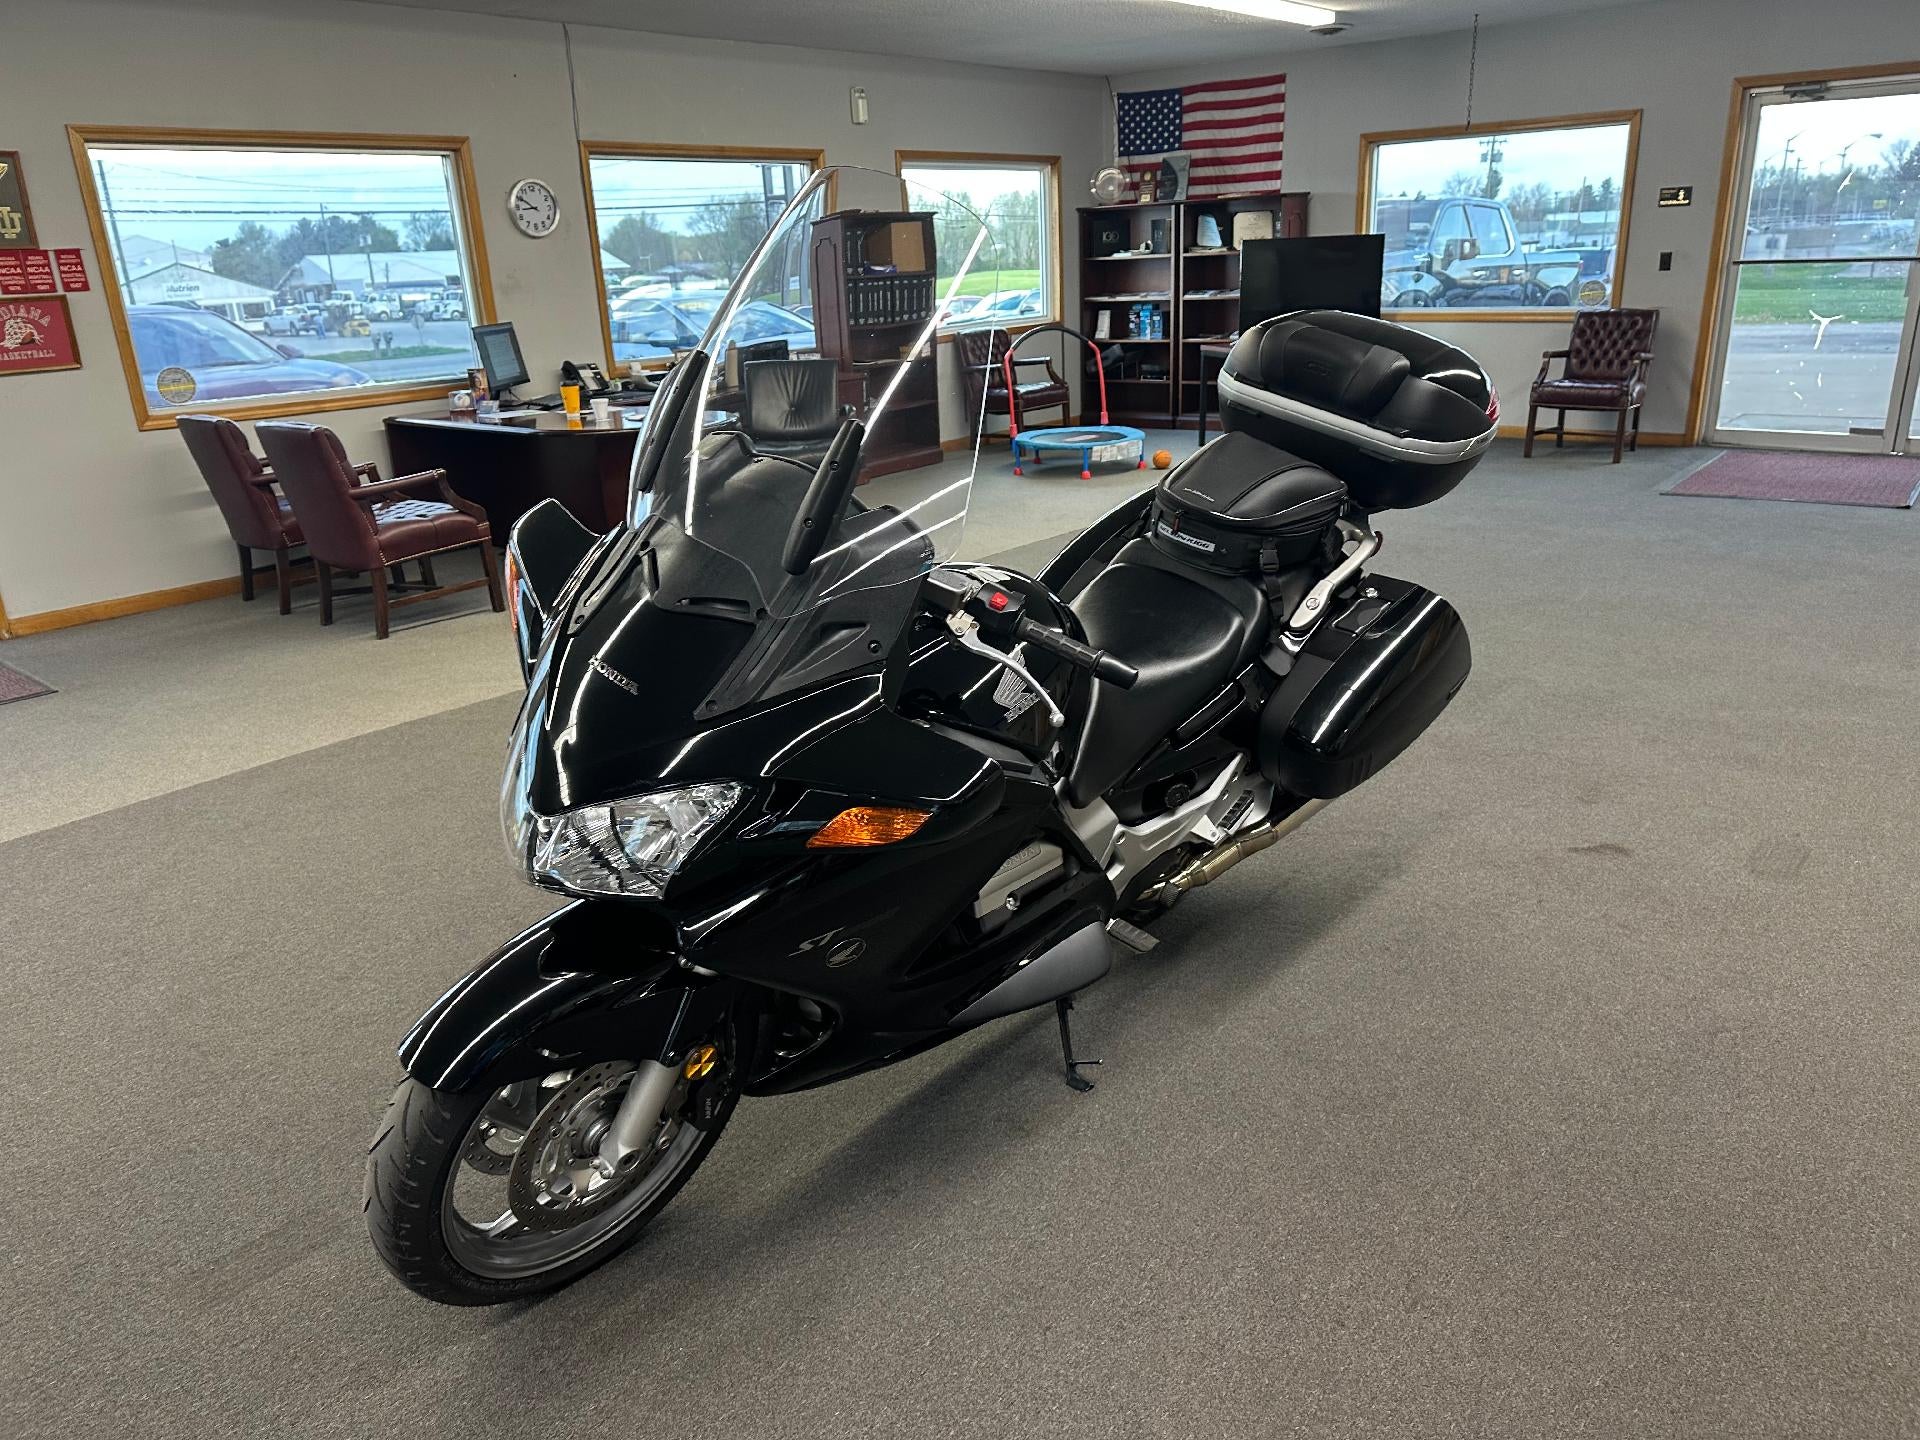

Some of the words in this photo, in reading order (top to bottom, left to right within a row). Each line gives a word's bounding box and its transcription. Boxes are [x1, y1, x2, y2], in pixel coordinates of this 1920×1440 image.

[59, 264, 82, 272] NCAA
[0, 304, 51, 327] DIANA
[587, 654, 641, 696] HONDA
[1002, 847, 1036, 869] ONDA
